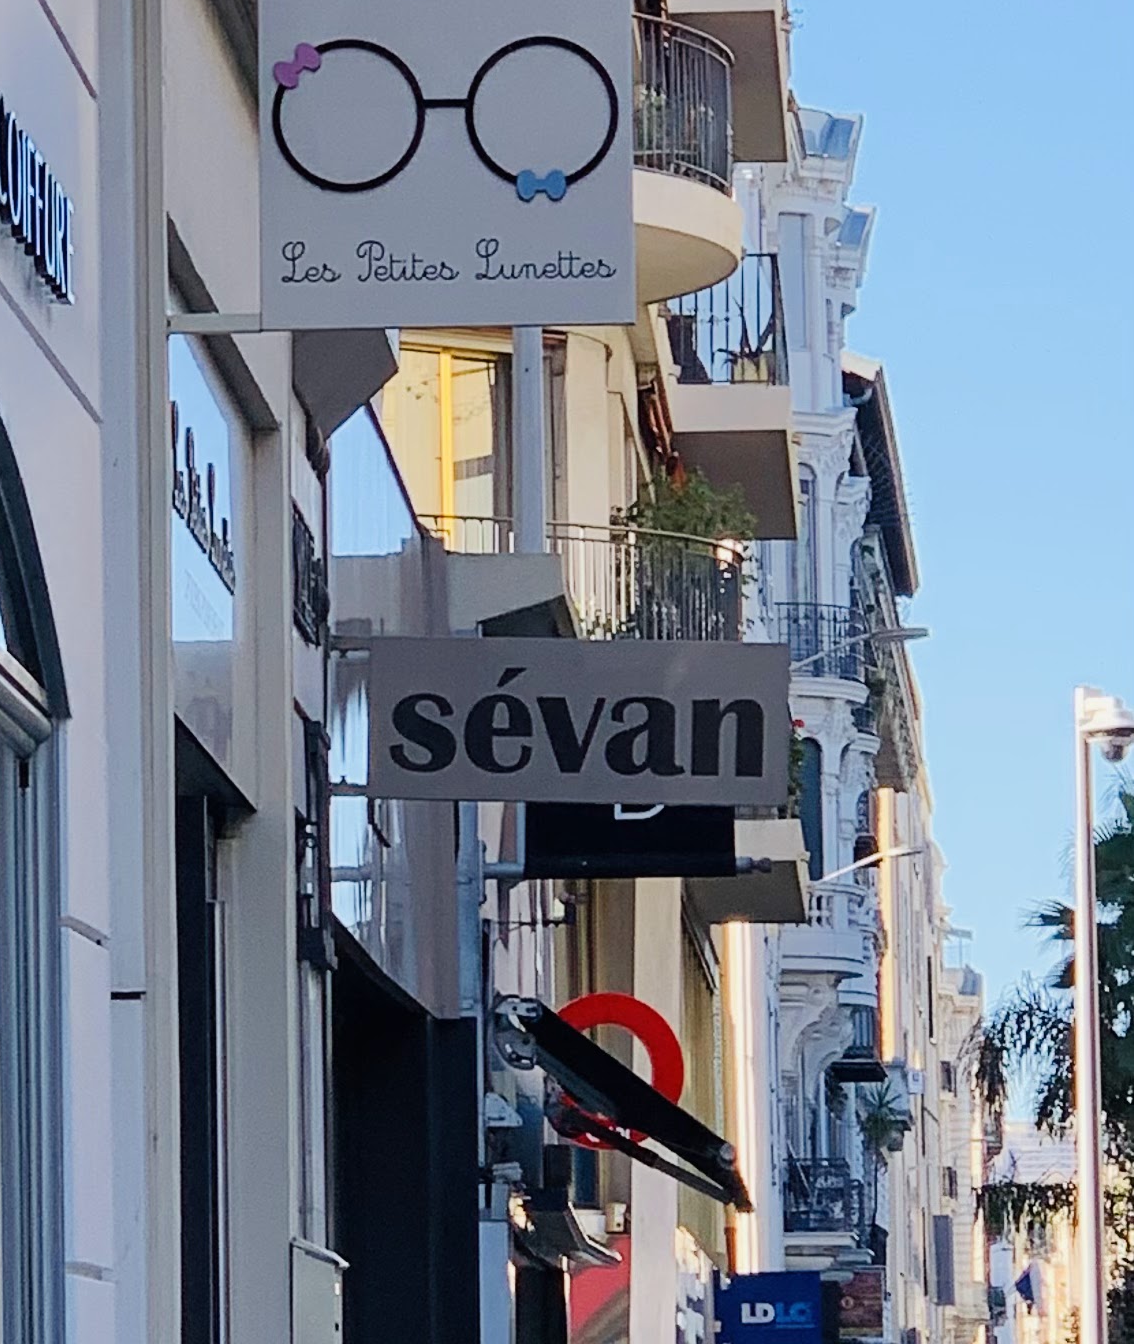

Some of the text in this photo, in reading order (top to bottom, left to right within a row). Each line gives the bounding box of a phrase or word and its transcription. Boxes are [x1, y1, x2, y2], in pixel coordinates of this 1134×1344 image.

[280, 237, 618, 284] Les Petites Lunettes
[388, 666, 766, 778] sévan
